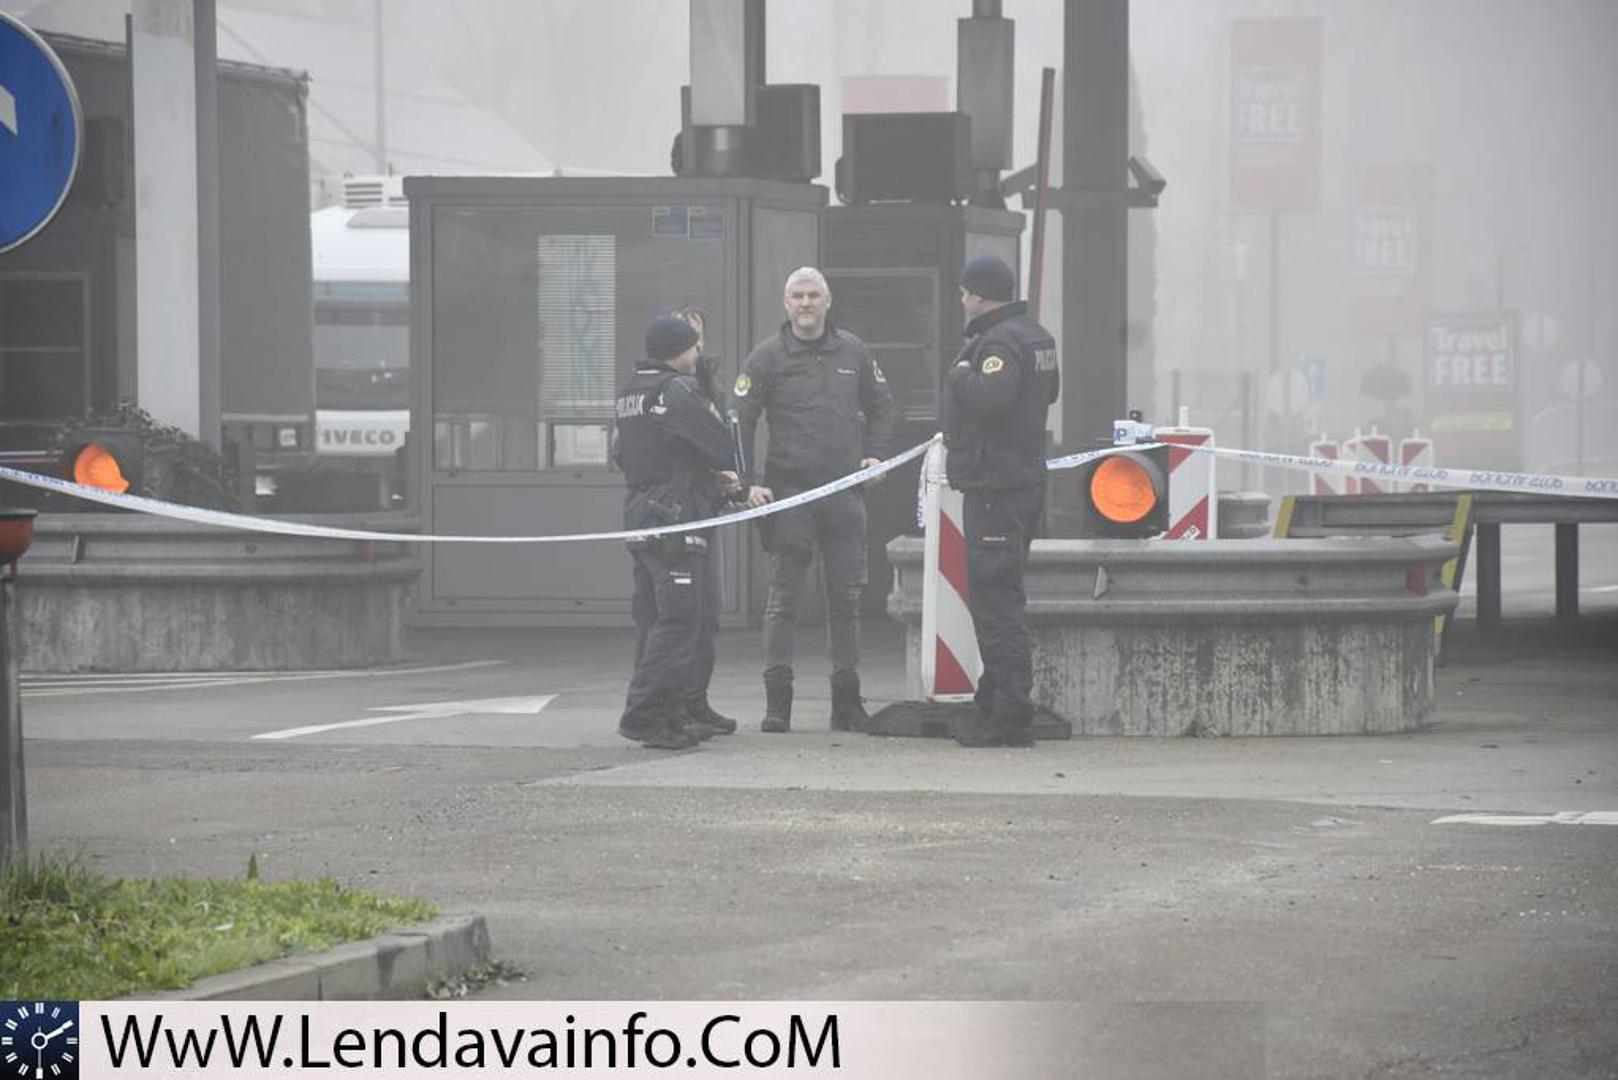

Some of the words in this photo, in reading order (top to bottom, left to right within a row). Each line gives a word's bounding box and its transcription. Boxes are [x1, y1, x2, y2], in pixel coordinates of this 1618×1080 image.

[1431, 324, 1507, 352] Travel
[1434, 353, 1507, 385] FREE
[323, 429, 396, 445] IVECO
